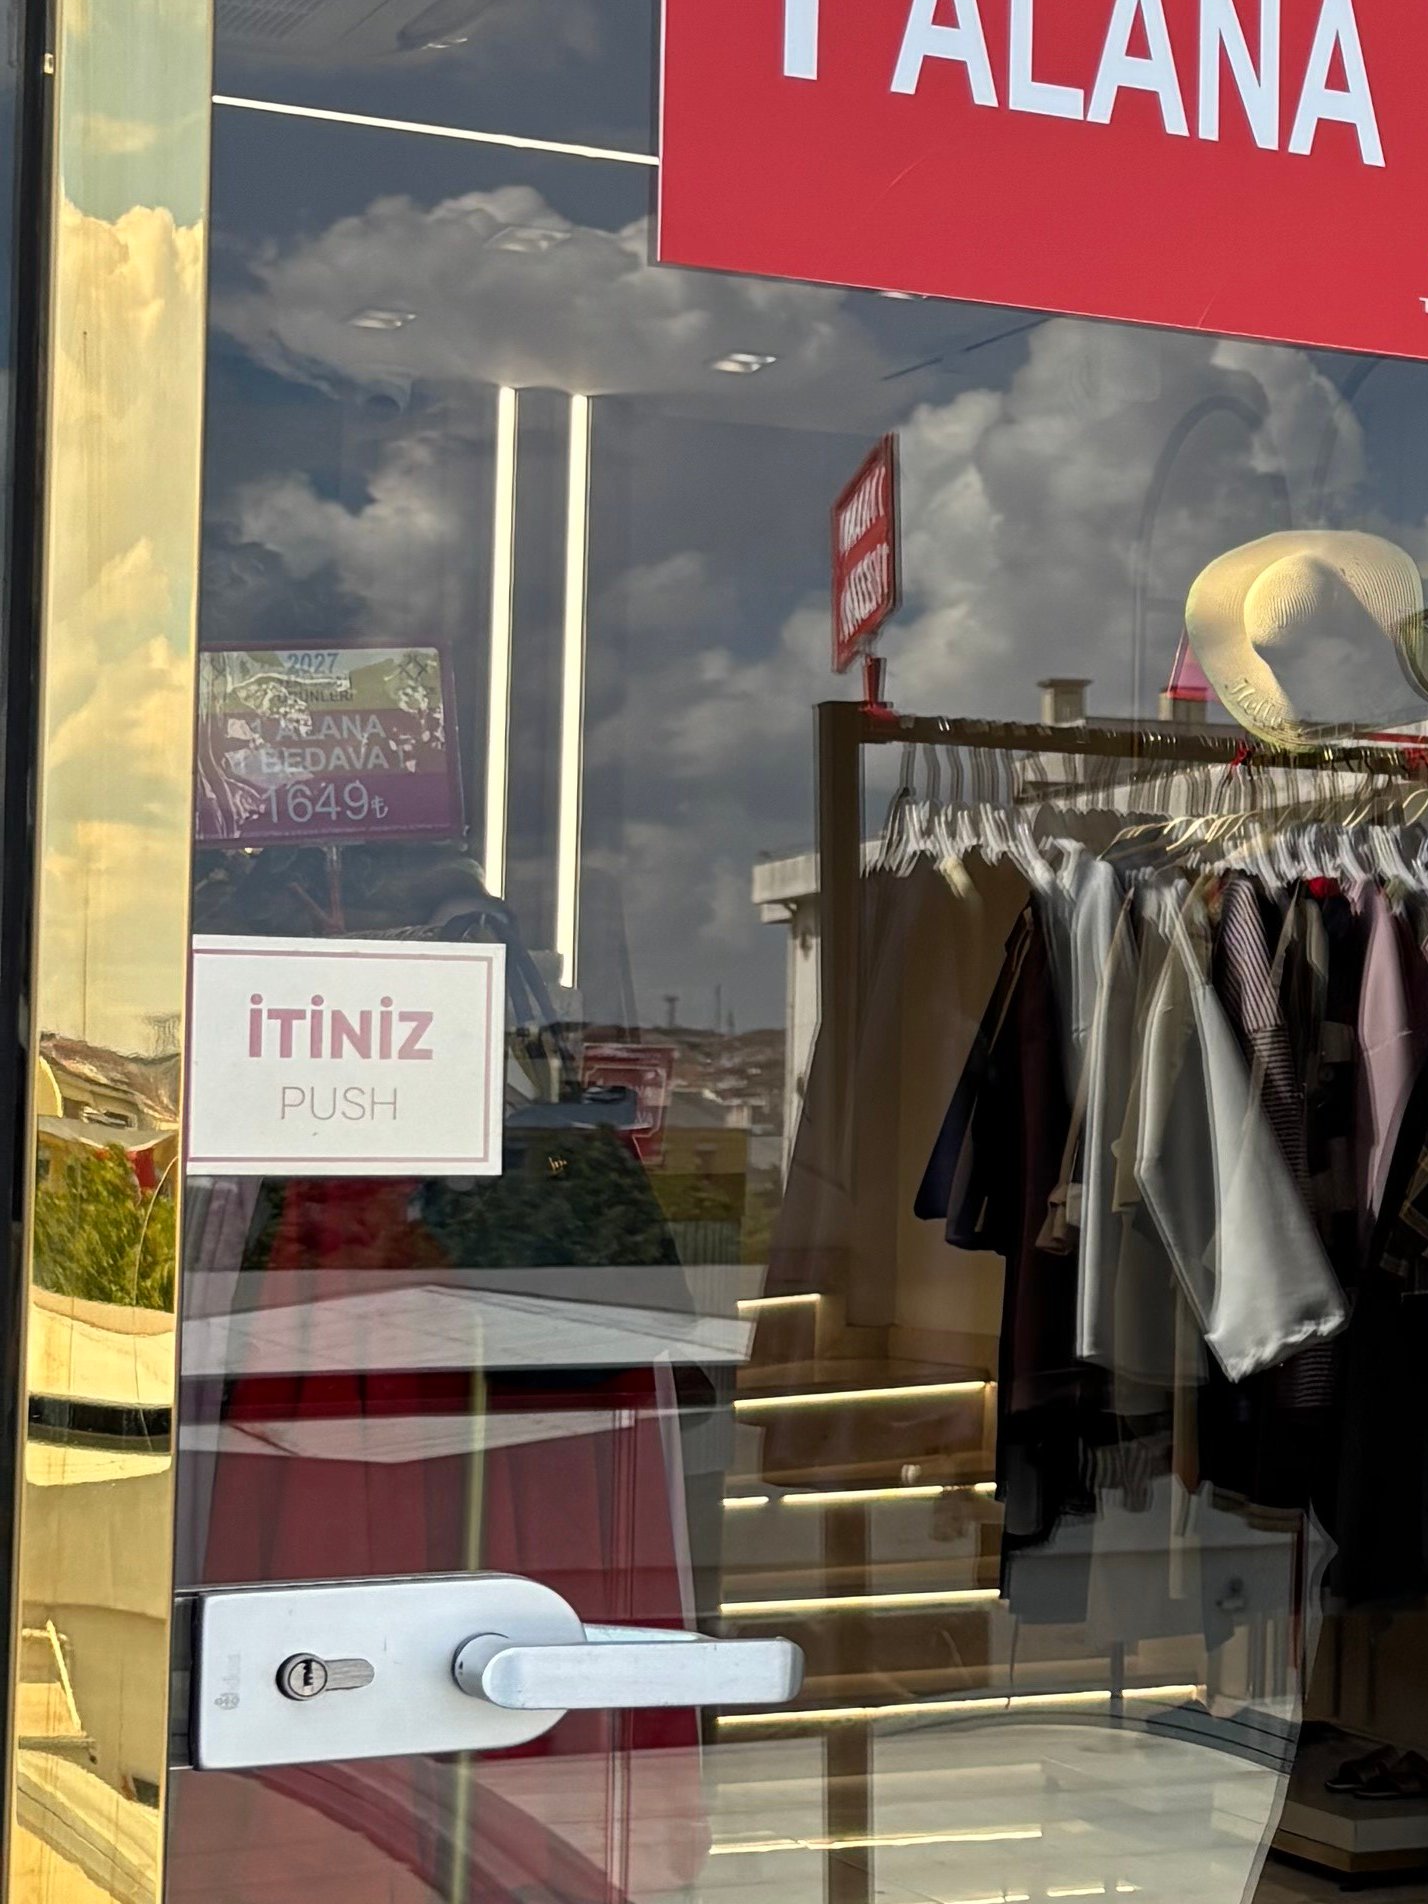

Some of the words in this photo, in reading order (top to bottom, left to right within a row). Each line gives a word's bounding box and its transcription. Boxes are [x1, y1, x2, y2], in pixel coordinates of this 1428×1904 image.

[261, 745, 390, 774] BEDAVA
[247, 993, 434, 1061] İTİNİZ
[280, 1086, 399, 1121] PUSH
